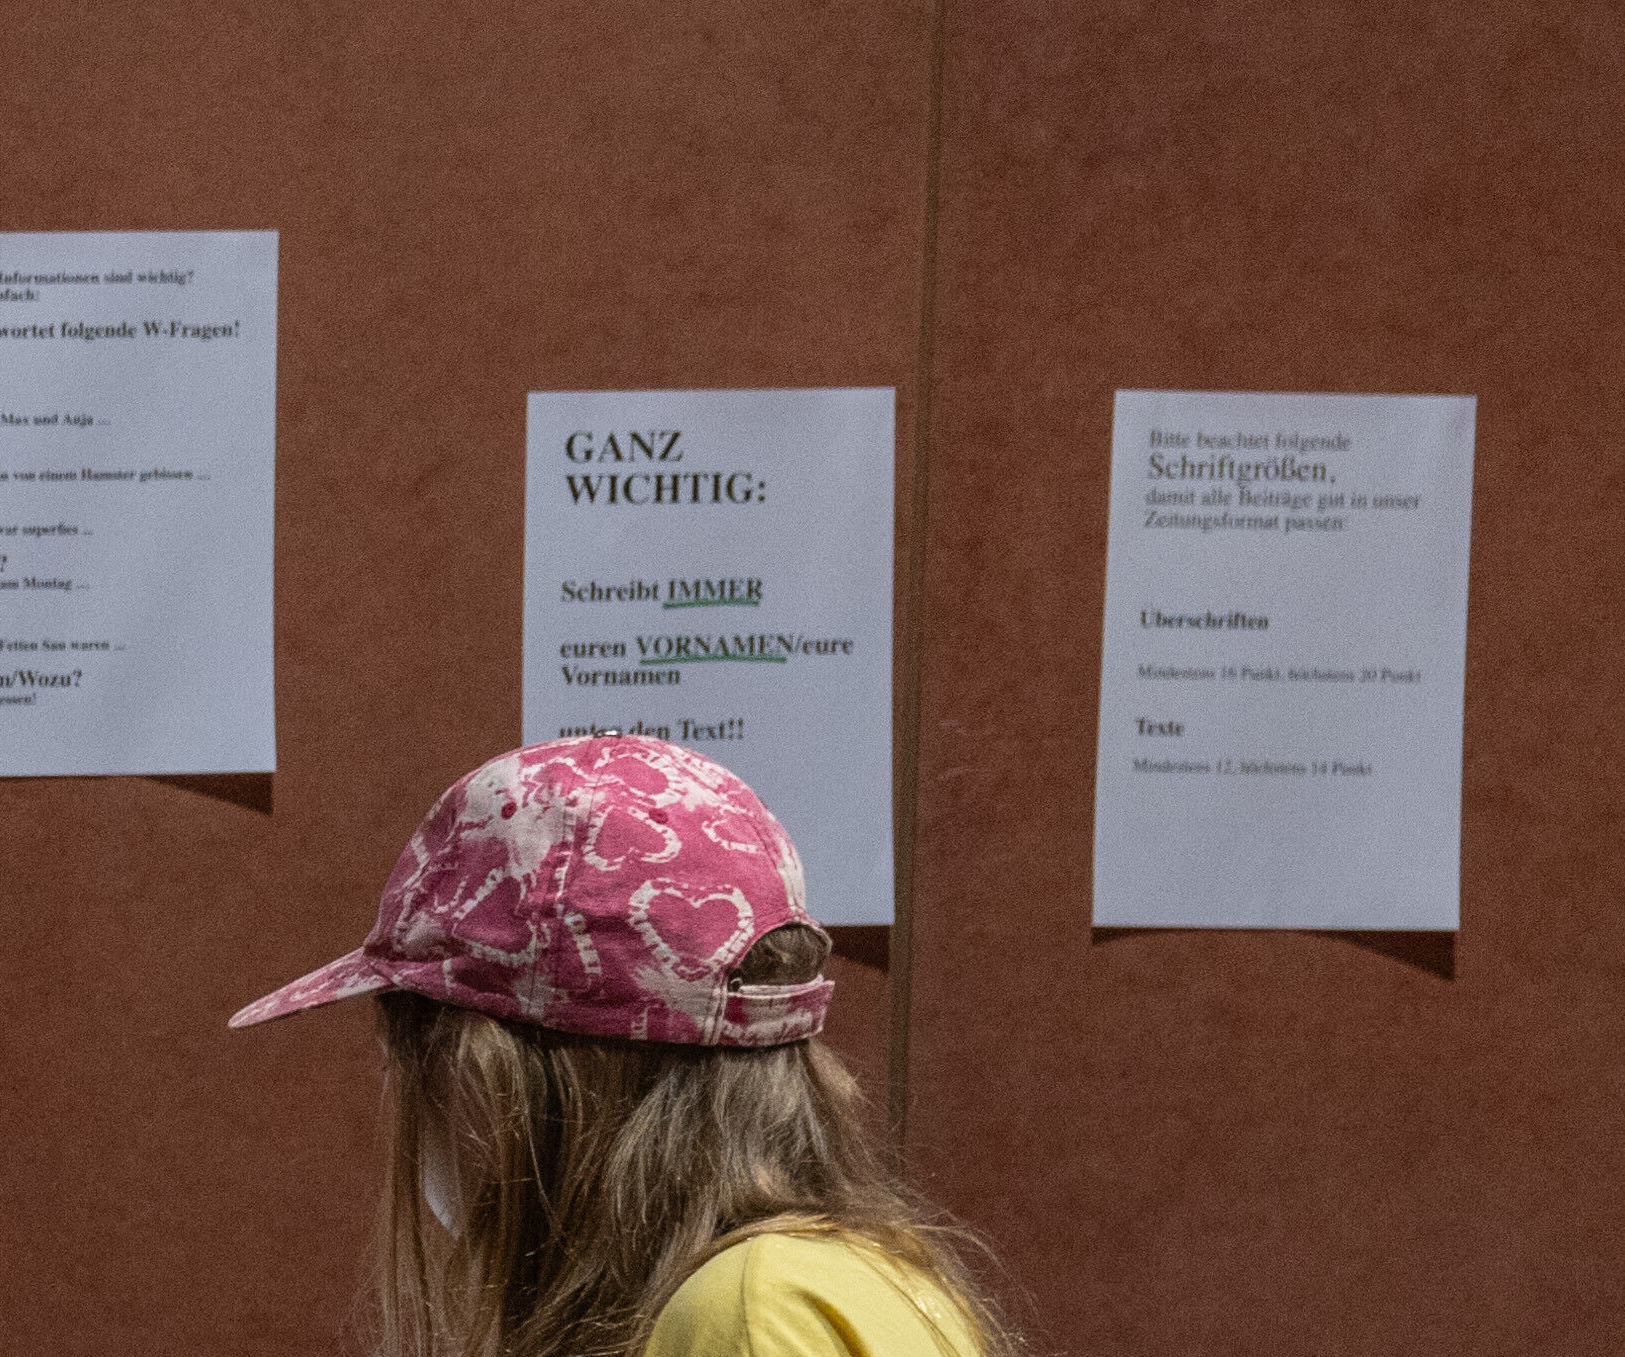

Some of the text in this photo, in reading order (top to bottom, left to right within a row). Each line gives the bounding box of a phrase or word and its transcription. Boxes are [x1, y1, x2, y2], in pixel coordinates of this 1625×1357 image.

[564, 430, 683, 463] GANZ
[1147, 454, 1337, 488] Schriftgrößen,
[565, 472, 766, 504] WICHTIG:
[561, 577, 763, 603] Schreibt IMMER
[559, 634, 854, 660] euren VORNAMEN/eure
[561, 665, 681, 687] Vornamen
[678, 718, 744, 740] Text!!
